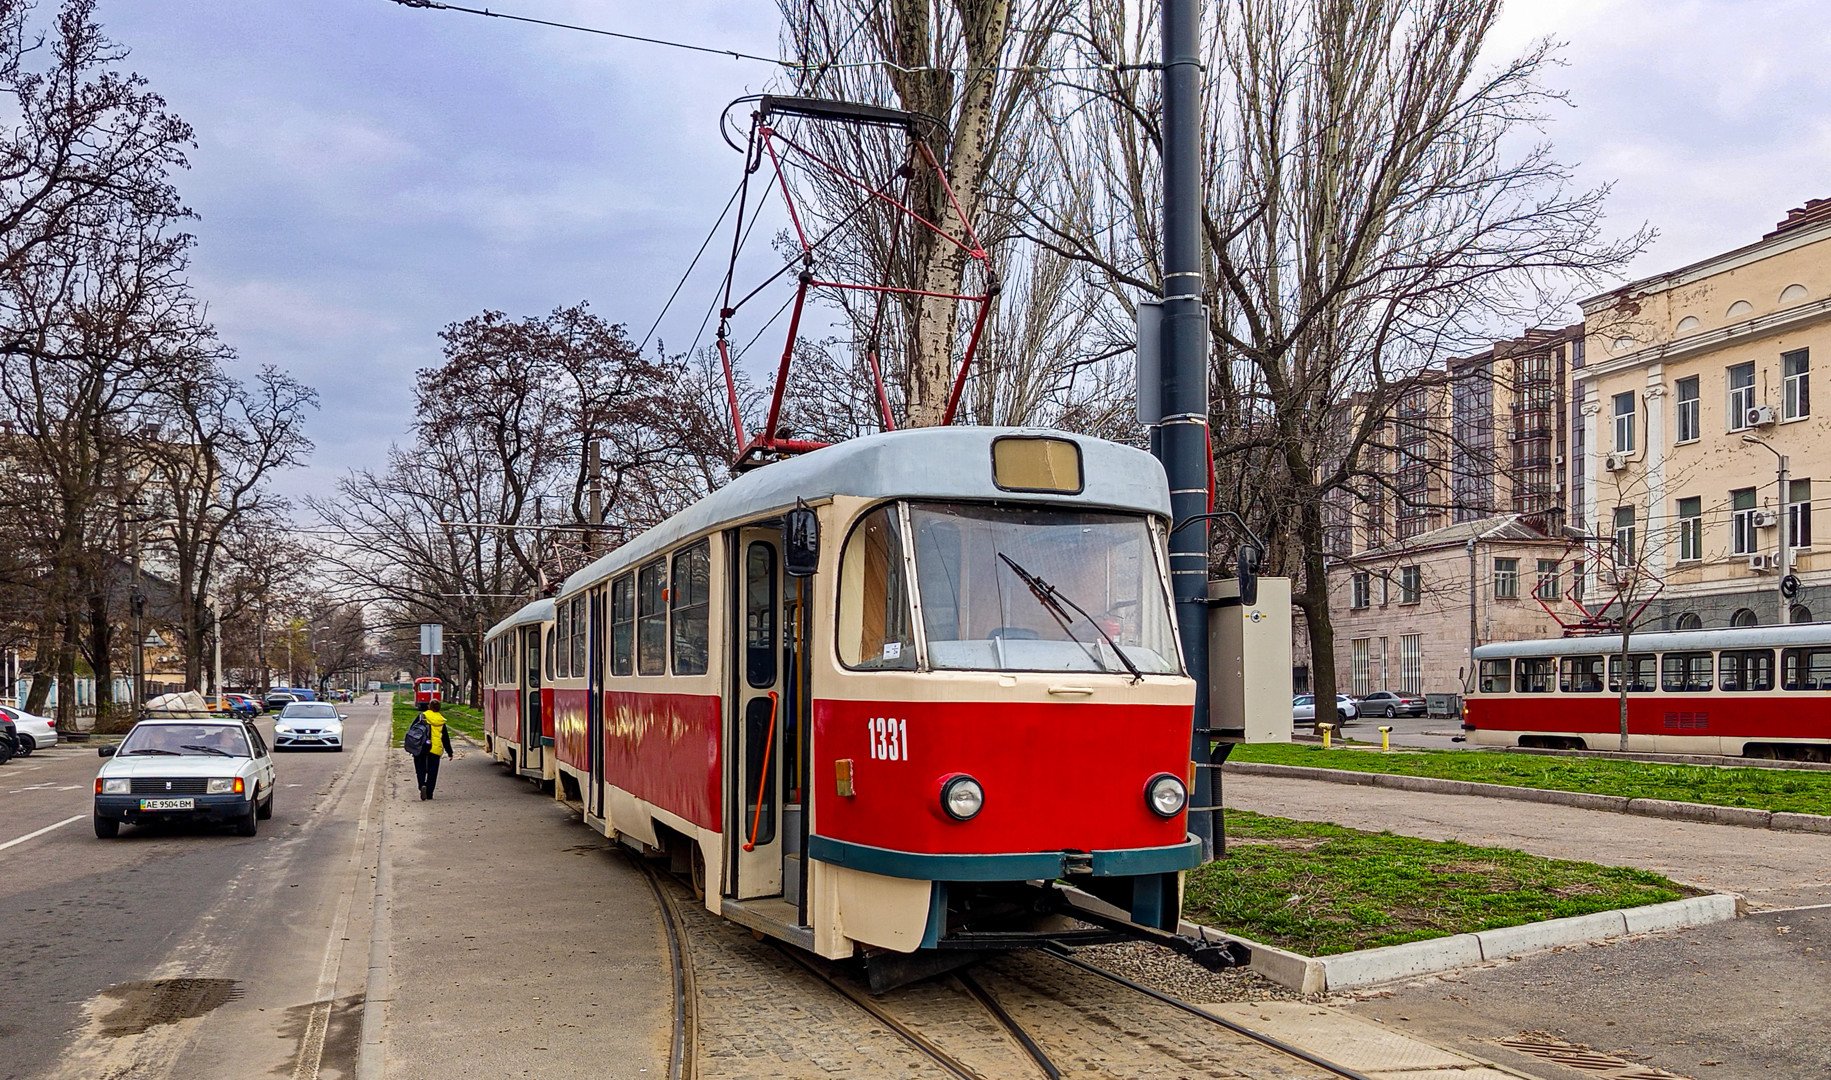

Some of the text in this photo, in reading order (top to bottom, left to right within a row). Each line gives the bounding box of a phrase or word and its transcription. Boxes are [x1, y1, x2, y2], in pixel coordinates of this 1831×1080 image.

[868, 717, 908, 761] 1331
[146, 800, 192, 808] AE 9504 BM
